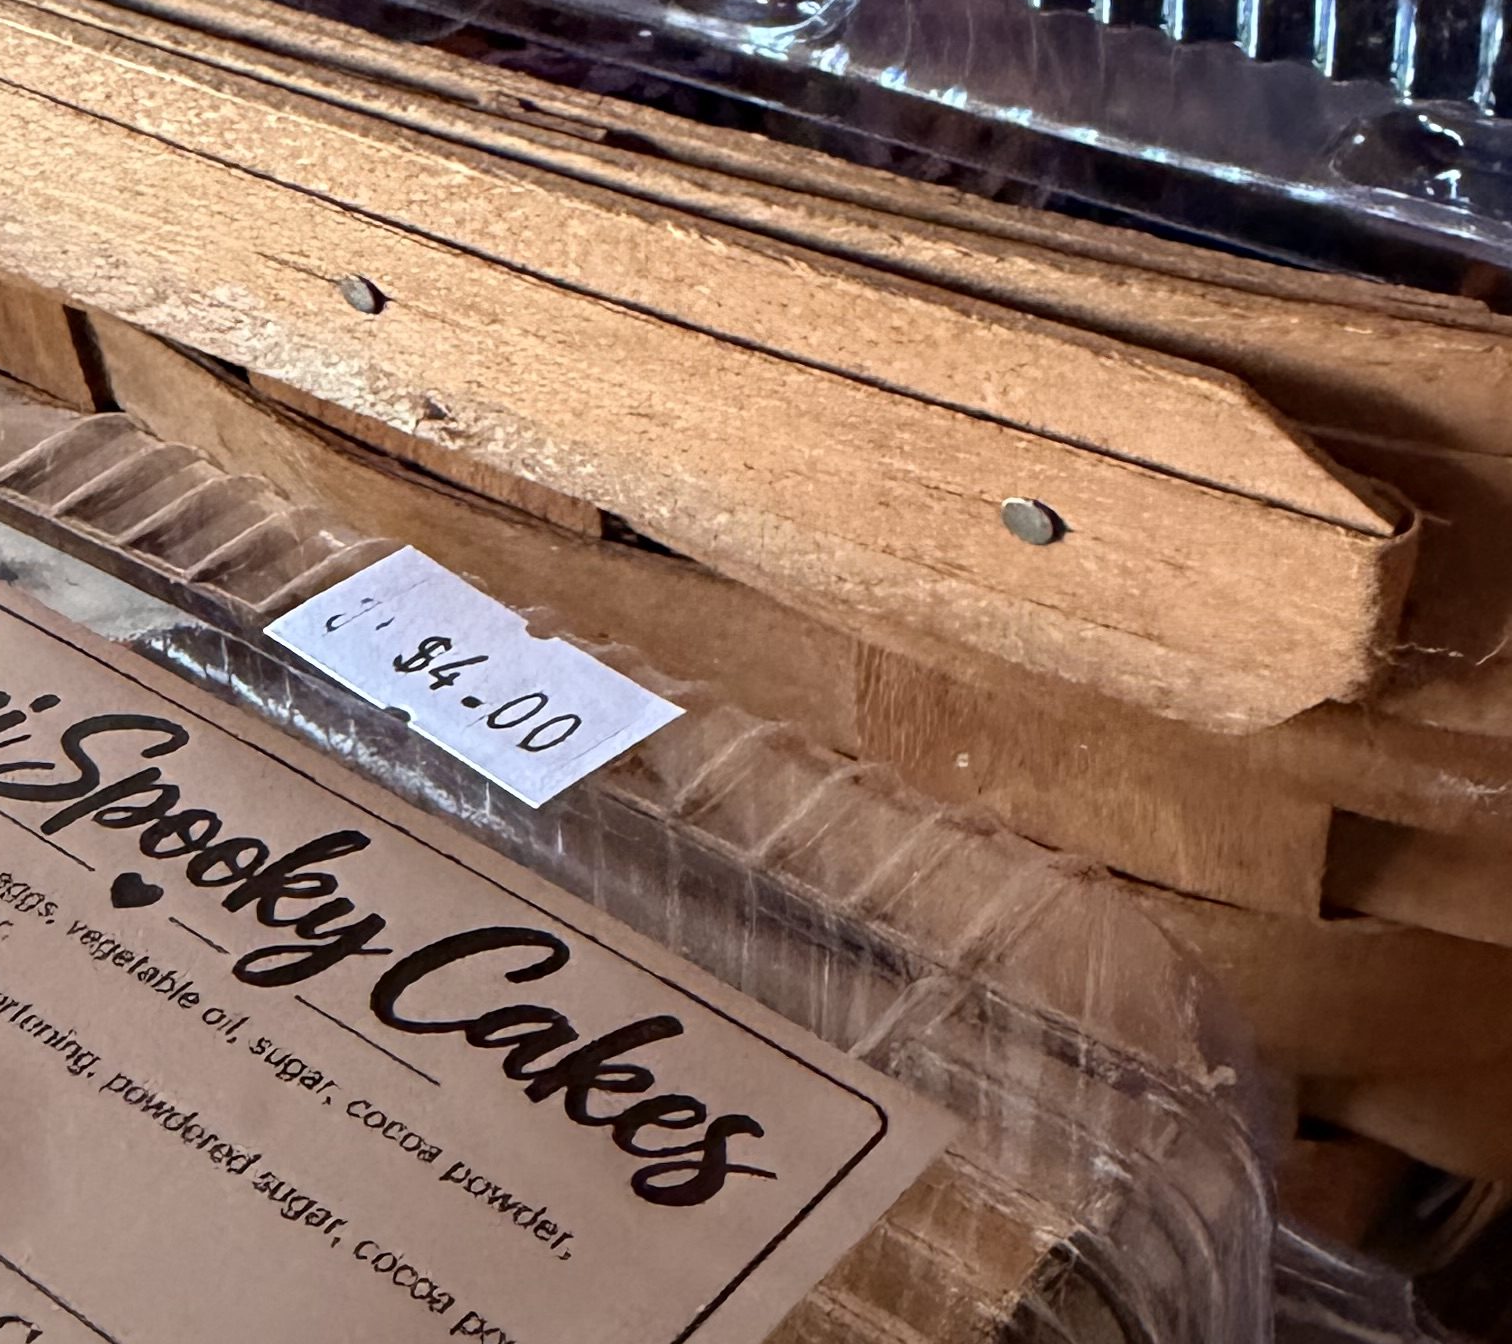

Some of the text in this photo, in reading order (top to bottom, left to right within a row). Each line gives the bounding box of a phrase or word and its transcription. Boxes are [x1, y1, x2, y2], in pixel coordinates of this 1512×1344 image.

[392, 635, 583, 753] $4.00
[66, 920, 200, 1009] vegetable
[201, 1007, 250, 1044] oil,
[248, 1036, 338, 1106] sugar,
[345, 1099, 443, 1164] cocoa
[438, 1161, 574, 1261] powder,
[98, 1072, 262, 1175] powdered
[251, 1171, 349, 1249] sugar,
[352, 1240, 456, 1315] cocoa
[370, 926, 778, 1207] Cakes
